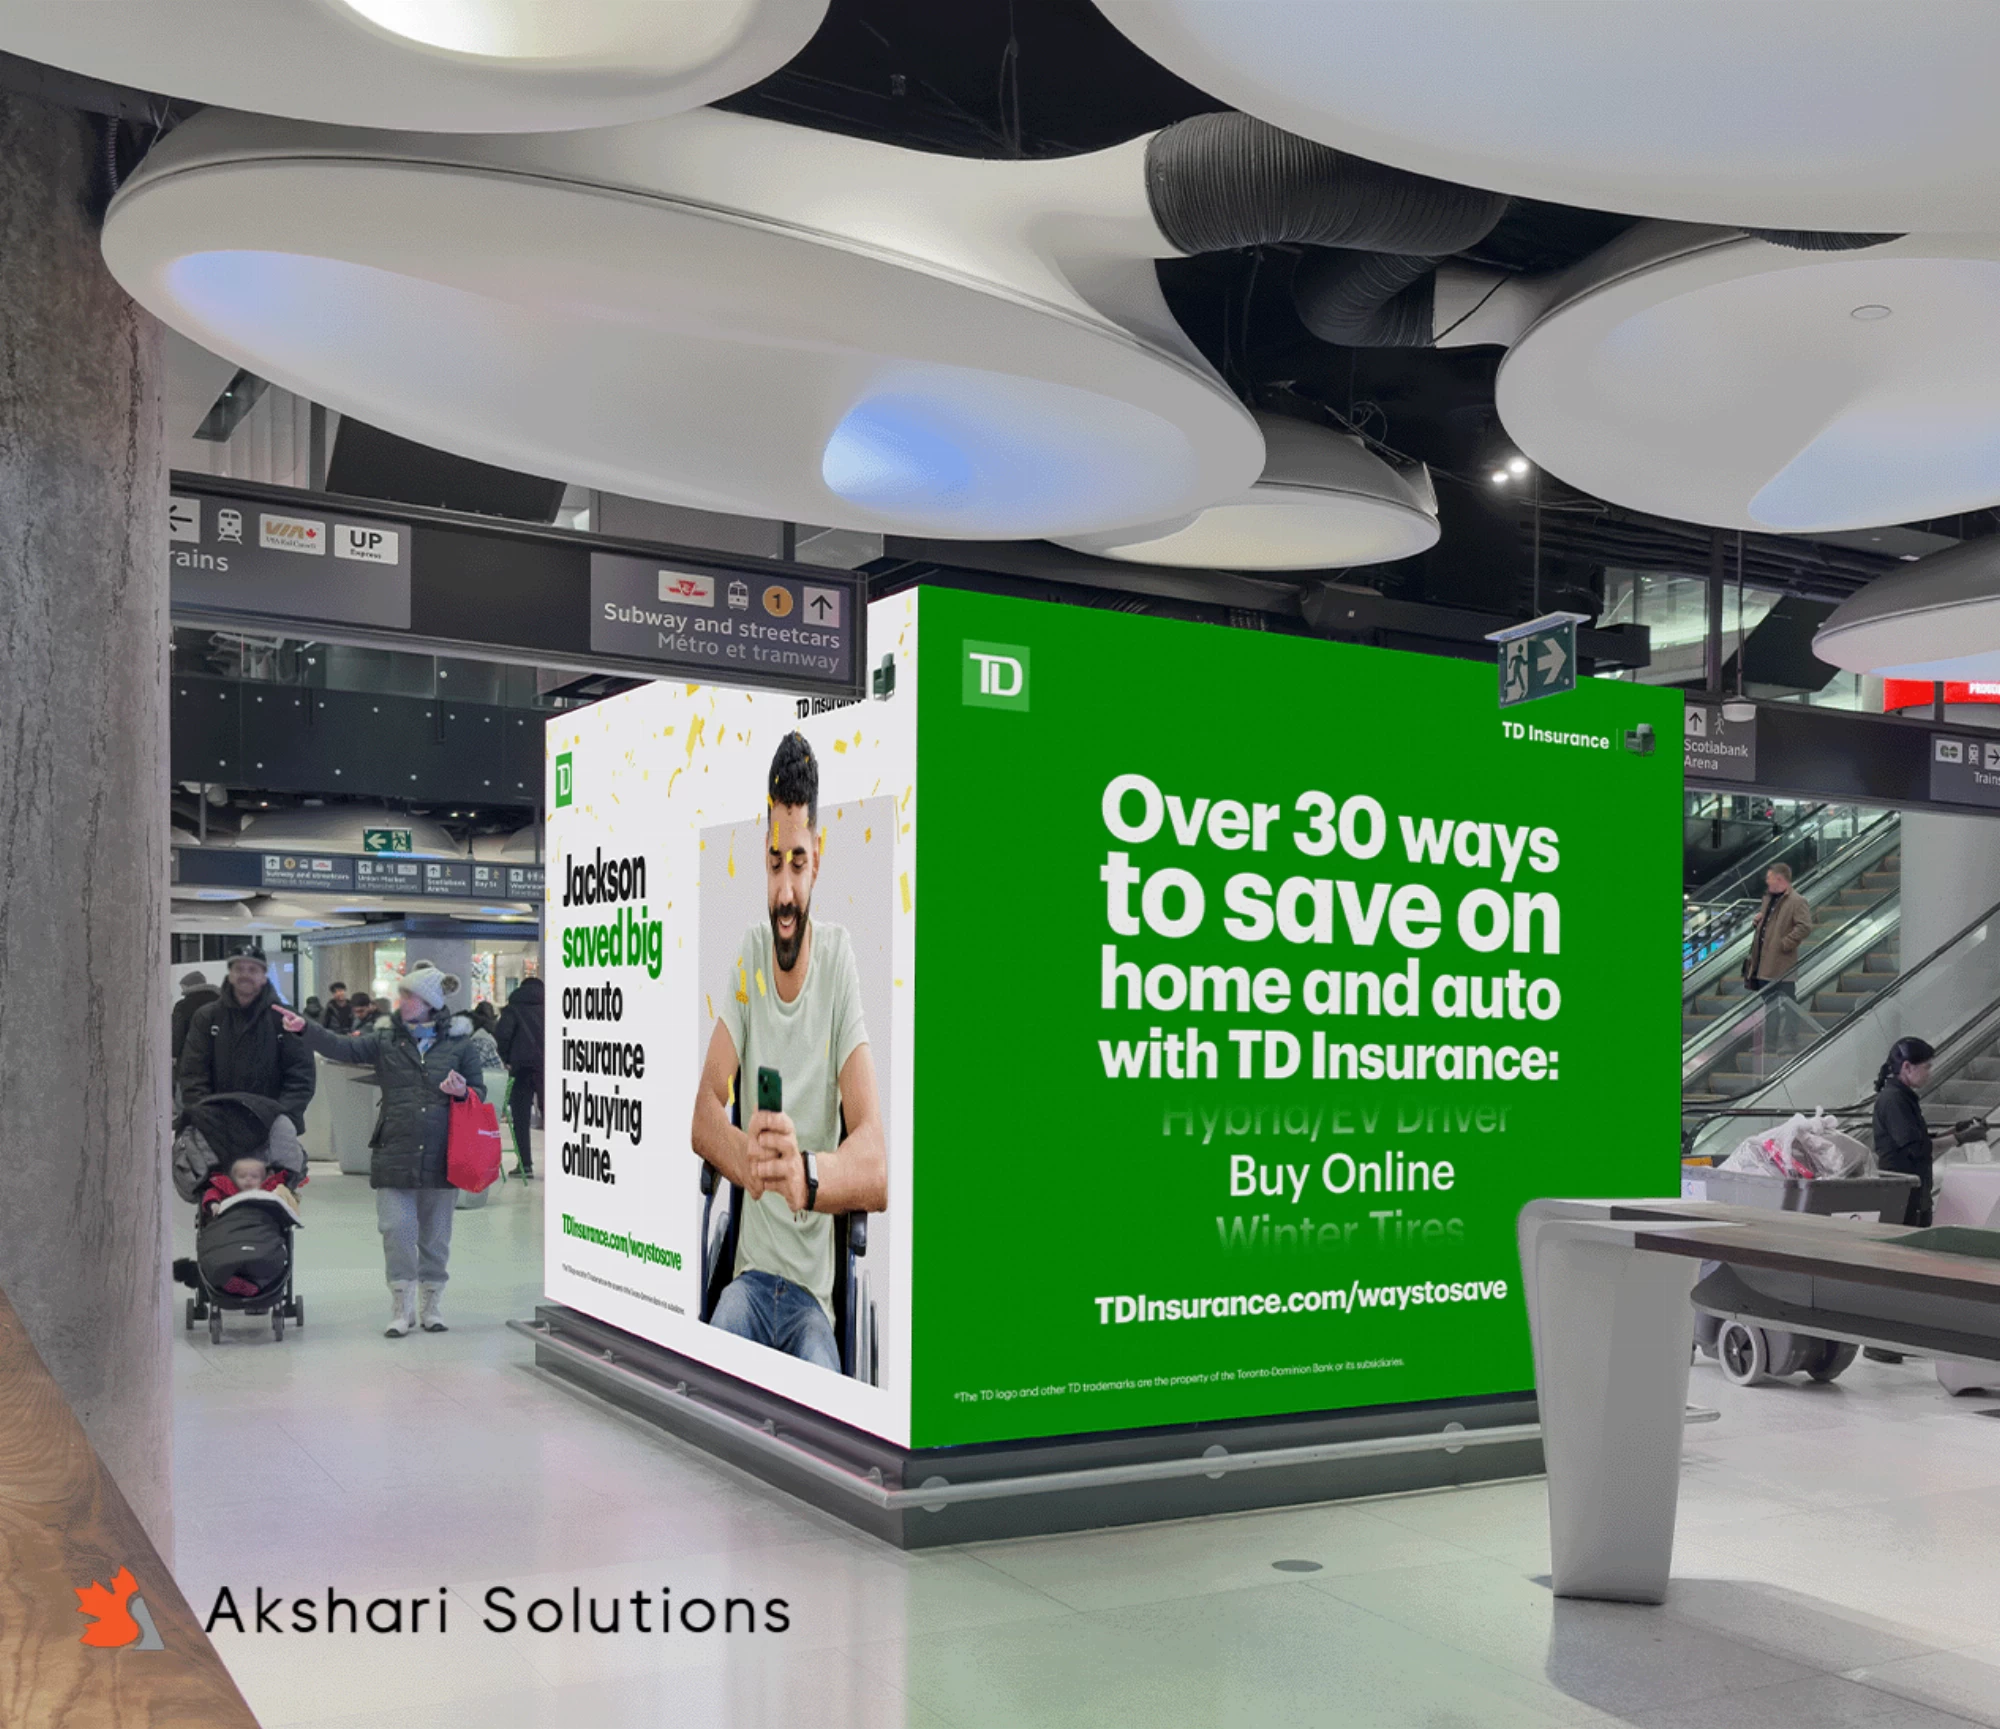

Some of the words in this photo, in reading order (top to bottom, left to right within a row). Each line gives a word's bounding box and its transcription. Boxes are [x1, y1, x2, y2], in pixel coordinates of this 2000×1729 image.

[265, 521, 304, 539] VIA
[350, 530, 383, 549] UP
[350, 549, 382, 560] Express
[771, 593, 781, 610] 1
[604, 602, 687, 633] Subway
[694, 617, 732, 635] and
[739, 623, 840, 649] streetcars
[657, 631, 718, 656] Métro
[726, 642, 746, 659] et
[753, 645, 840, 674] tramway
[970, 653, 1022, 696] TD
[796, 698, 810, 719] TD
[1502, 721, 1525, 739] TD
[1529, 724, 1610, 750] Insurance
[1684, 739, 1749, 757] Scotiabank
[557, 764, 572, 797] TD
[1684, 755, 1719, 770] Arena
[1102, 774, 1280, 851] Over
[1293, 790, 1386, 859] 30
[1398, 816, 1560, 883] ways
[563, 846, 646, 907] Jackson
[1100, 851, 1206, 938] to
[1223, 872, 1442, 949] save
[1458, 888, 1561, 954] on
[562, 908, 623, 969] saved
[627, 905, 663, 980] big
[562, 987, 582, 1020] on
[585, 981, 623, 1022] auto
[1101, 945, 1291, 1013] home
[1303, 958, 1420, 1016] and
[1432, 969, 1562, 1020] auto
[562, 1026, 645, 1079] insurance
[1098, 1027, 1218, 1079] with
[1229, 1030, 1301, 1079] TD
[1313, 1031, 1559, 1080] Insurance:
[562, 1078, 582, 1133] by
[584, 1081, 642, 1146] buying
[562, 1133, 615, 1185] online.
[1230, 1154, 1311, 1204] Buy
[1322, 1150, 1455, 1194] Online
[1216, 1213, 1358, 1251] Winter
[1369, 1209, 1464, 1246] Tires
[1095, 1280, 1508, 1325] TDInsurance.com/waystosave
[980, 1390, 994, 1400] TD
[995, 1390, 1018, 1400] logo
[1019, 1386, 1039, 1397] and
[1040, 1385, 1066, 1395] other
[1068, 1383, 1081, 1393] TD
[1082, 1379, 1136, 1392] trademarks
[1137, 1379, 1152, 1387] are
[1154, 1376, 1169, 1386] the
[1170, 1374, 1208, 1386] property
[1210, 1372, 1219, 1381] of
[1221, 1371, 1235, 1380] the
[1237, 1366, 1311, 1379] Toronto-Dominion
[1313, 1363, 1333, 1373] Bank
[1357, 1359, 1404, 1369] subsidiaries.
